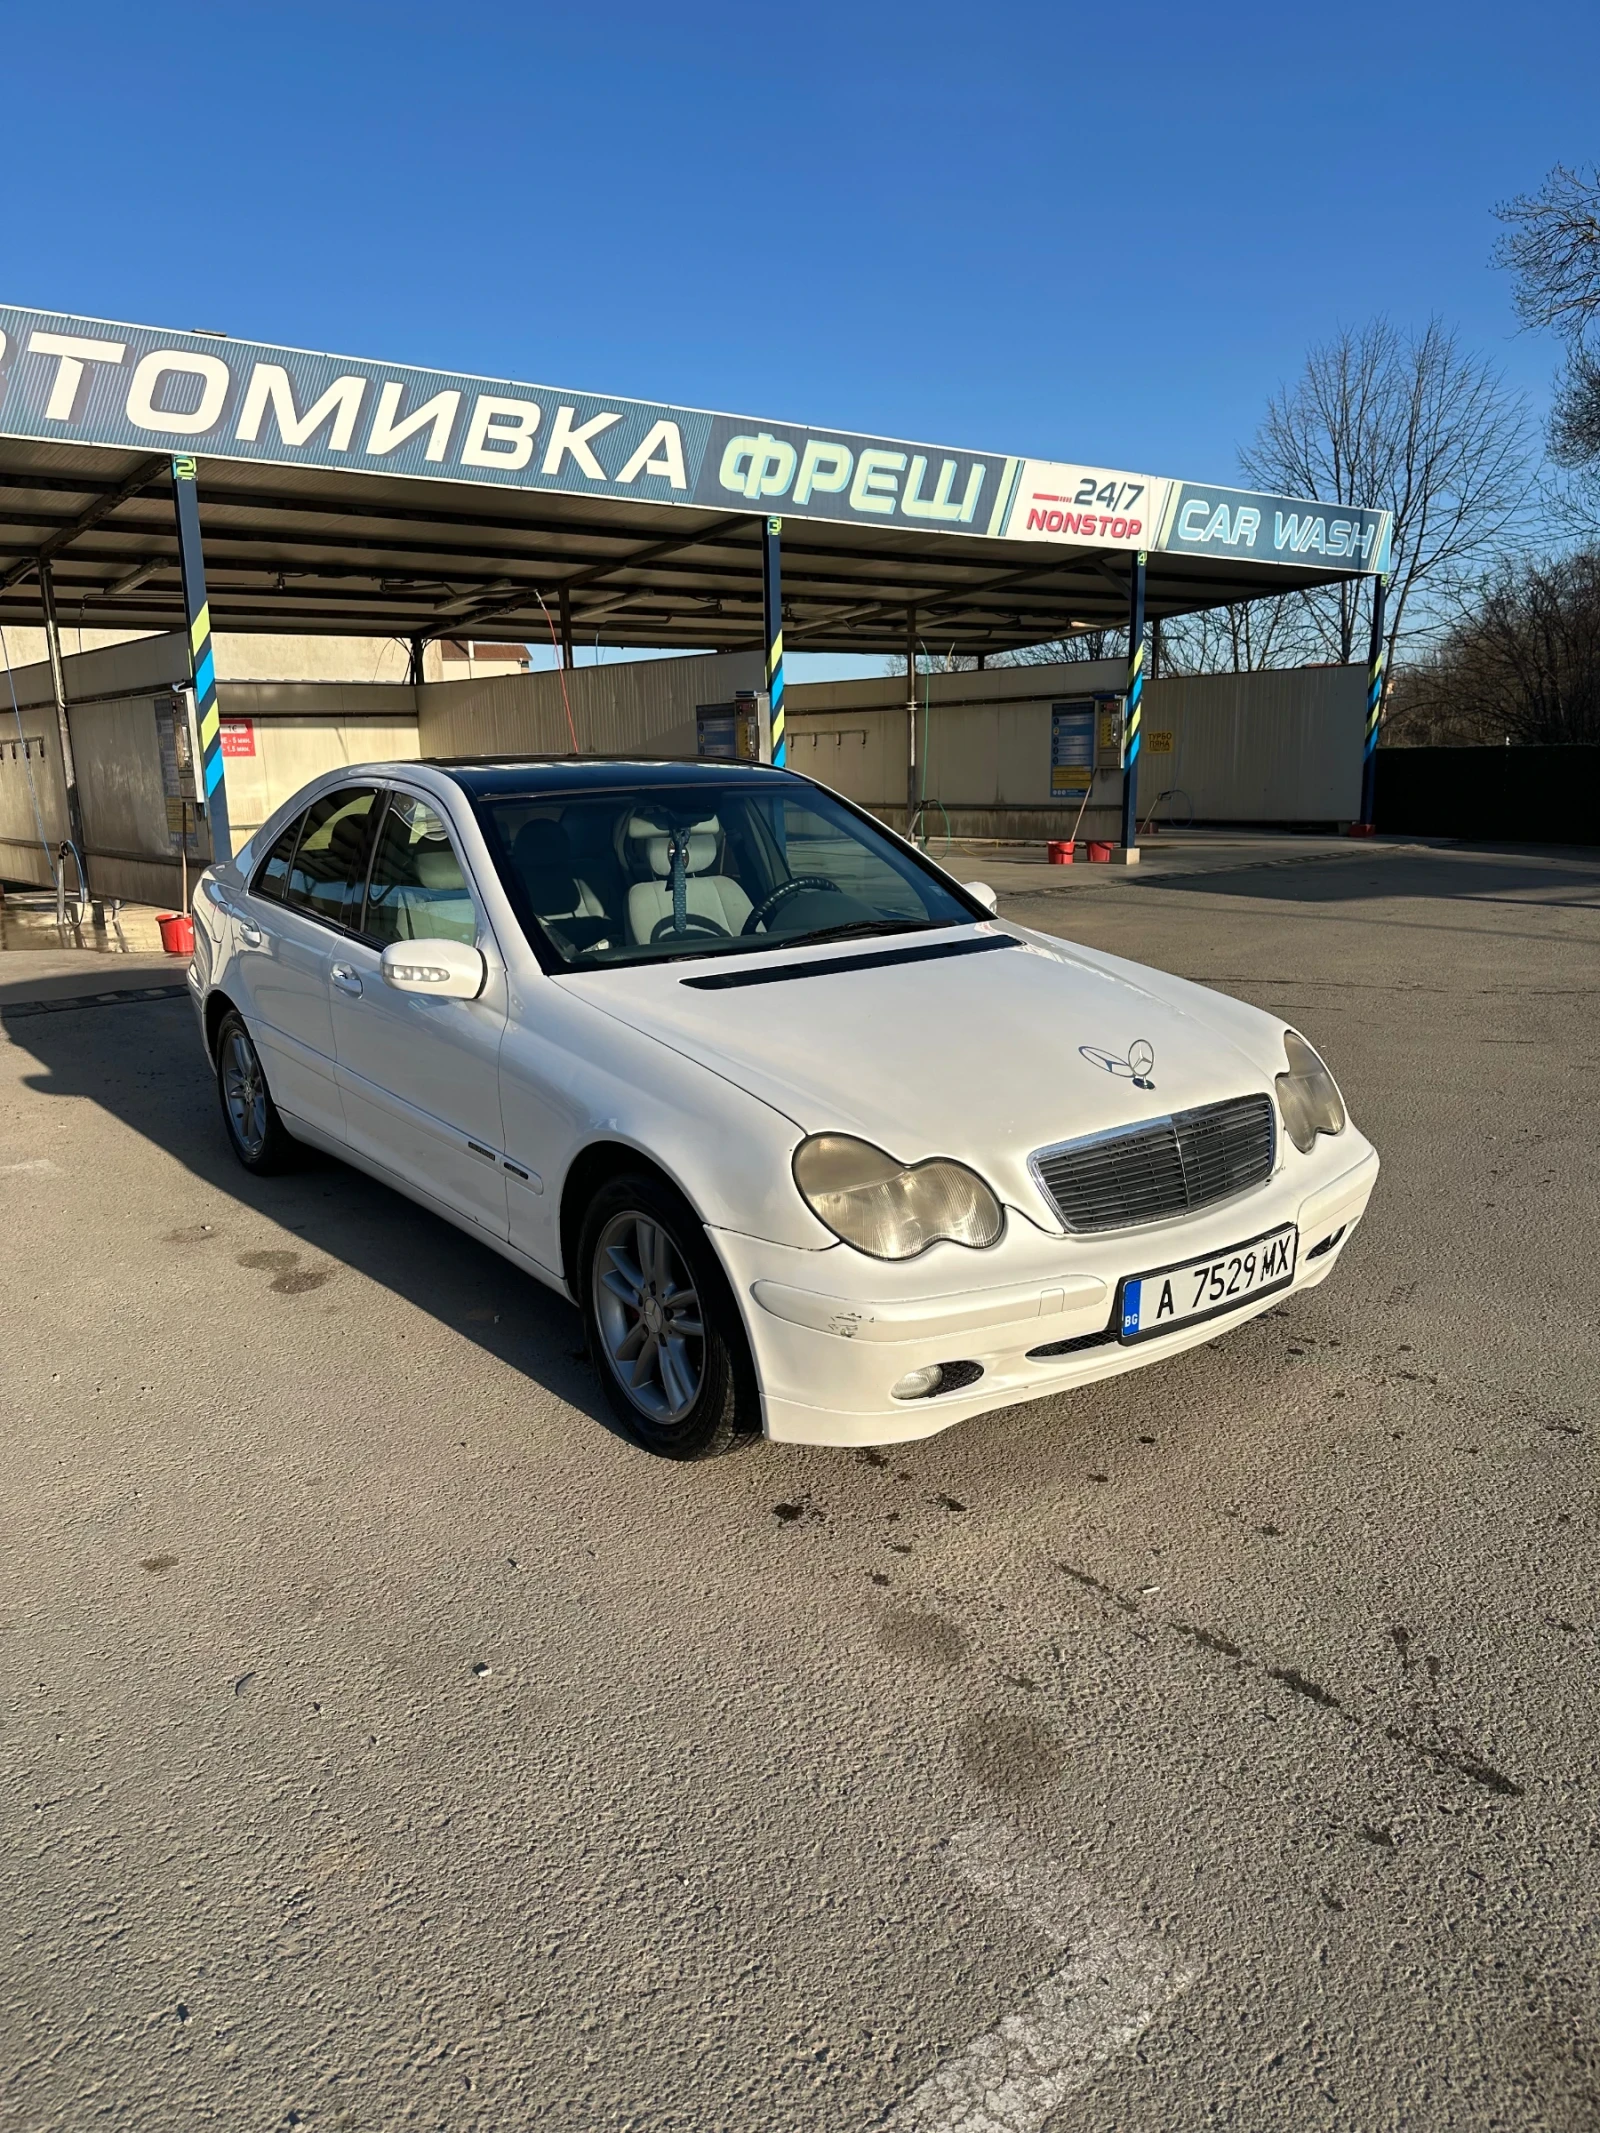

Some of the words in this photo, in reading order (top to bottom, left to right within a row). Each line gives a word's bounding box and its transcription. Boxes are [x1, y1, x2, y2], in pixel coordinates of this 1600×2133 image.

[0, 329, 688, 489] ТОМИВКА
[719, 433, 986, 523] ФРЕШ
[176, 459, 195, 477] 2
[1074, 478, 1145, 512] 24/7
[769, 518, 781, 532] 3
[1026, 508, 1142, 539] NONSTOP
[1178, 499, 1261, 547] CAR
[1274, 511, 1376, 559] WASH
[1148, 732, 1172, 740] ТУРБО
[1149, 740, 1170, 748] ПЯНА
[1156, 1279, 1175, 1319] A
[1191, 1252, 1257, 1309] 7529
[1260, 1235, 1292, 1282] MX
[1124, 1313, 1139, 1328] BG
